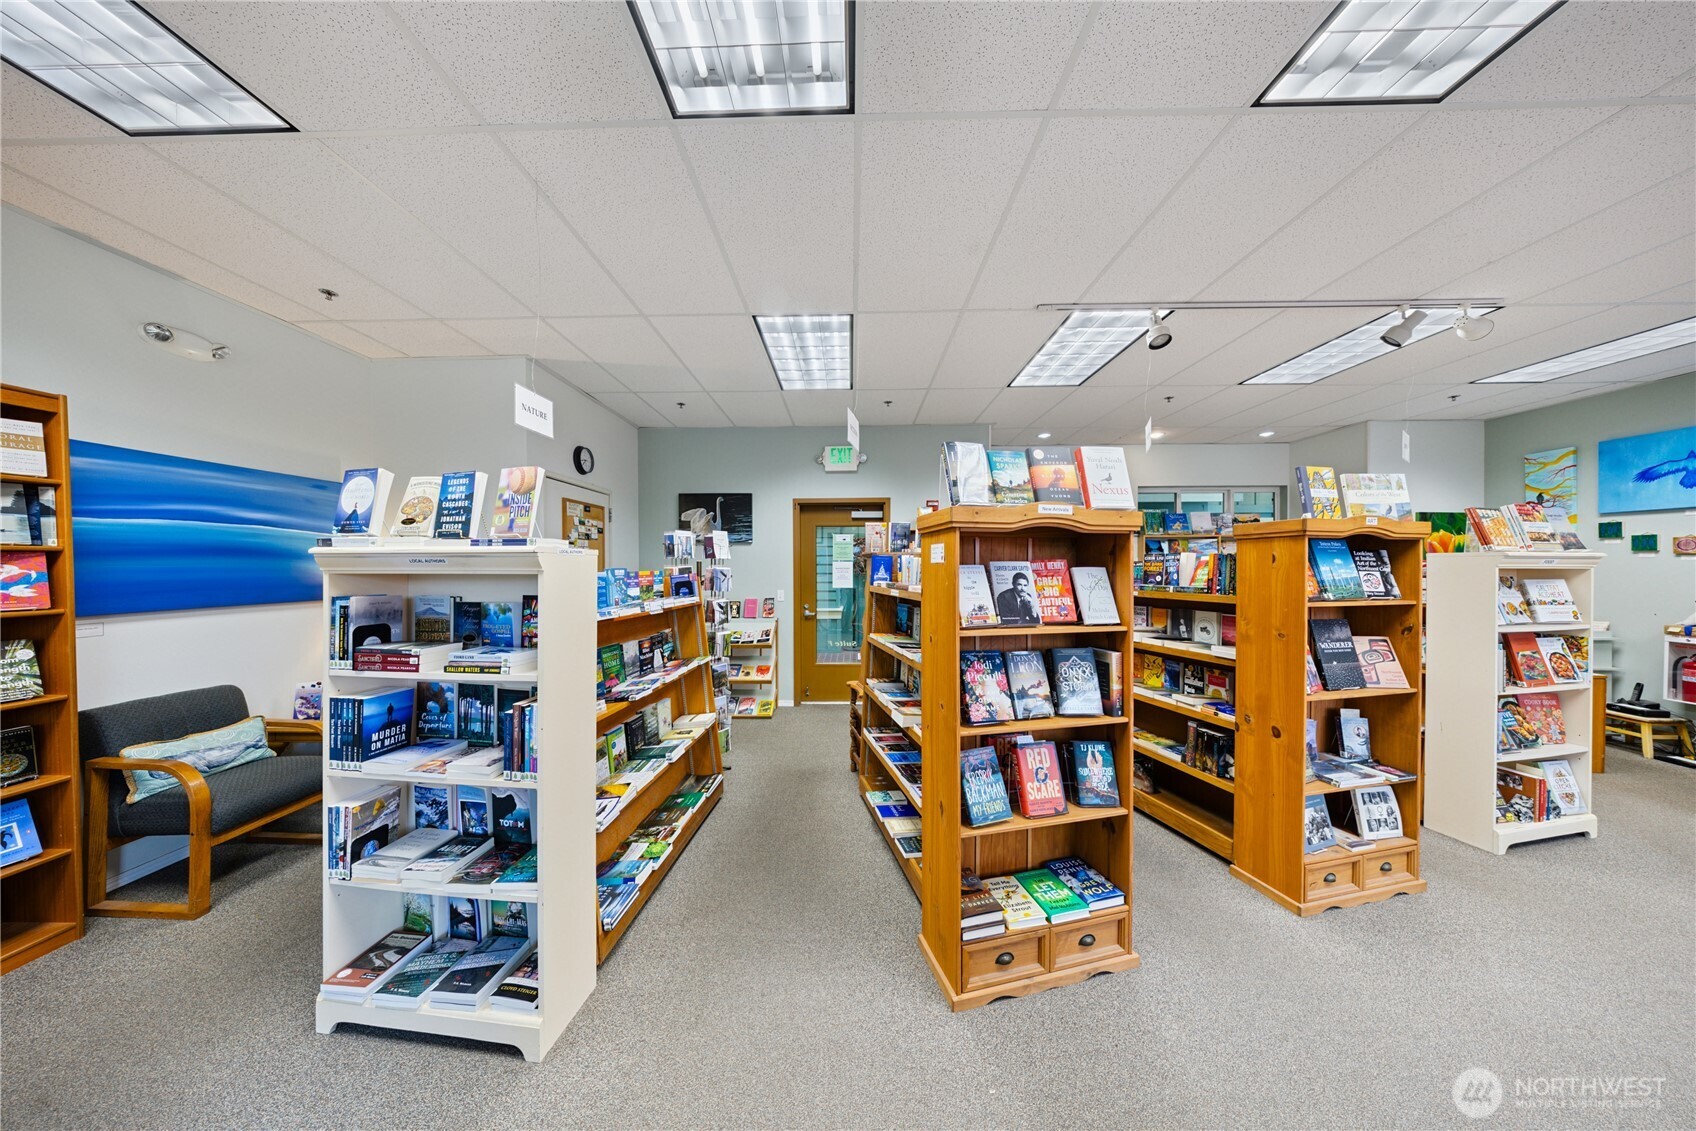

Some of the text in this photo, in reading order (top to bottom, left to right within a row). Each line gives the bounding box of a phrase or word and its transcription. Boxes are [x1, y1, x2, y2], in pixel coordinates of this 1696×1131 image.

[522, 402, 548, 420] NATURE
[830, 448, 852, 464] EXIT
[1092, 484, 1128, 495] Nexus
[508, 492, 532, 505] INSIDE
[509, 506, 530, 518] PITCH
[1037, 576, 1062, 585] GREAT
[1044, 586, 1060, 596] BIG
[1040, 606, 1058, 616] LIFE
[1014, 653, 1038, 662] DONNA
[604, 659, 620, 668] HOME
[974, 660, 992, 669] Jodi
[1011, 660, 1043, 673] LEON
[967, 671, 1003, 681] Picoult
[1061, 667, 1092, 678] ONYX
[1062, 682, 1096, 691] STORM
[440, 713, 447, 722] of
[418, 722, 452, 732] Departure
[372, 724, 406, 742] MURDER
[371, 741, 381, 750] ON
[384, 733, 406, 746] MATIA
[1026, 747, 1050, 770] RED
[1078, 767, 1113, 776] SOMEWHERE
[967, 768, 994, 786] FREDRIK
[1027, 779, 1061, 800] SCARE
[1098, 783, 1109, 791] SEA
[965, 782, 1004, 805] BACKMAN
[973, 800, 1006, 817] MY FRIENDS
[499, 819, 524, 828] TOTEM
[1050, 859, 1085, 870] LOUISE
[1058, 865, 1089, 874] PENNY
[1033, 881, 1056, 892] LET
[1079, 878, 1103, 888] GREY
[1081, 883, 1114, 896] WOLF
[1034, 888, 1072, 902] THEM
[969, 899, 994, 907] DARKER
[415, 953, 447, 962] MURDER
[407, 959, 445, 967] MAYHEM
